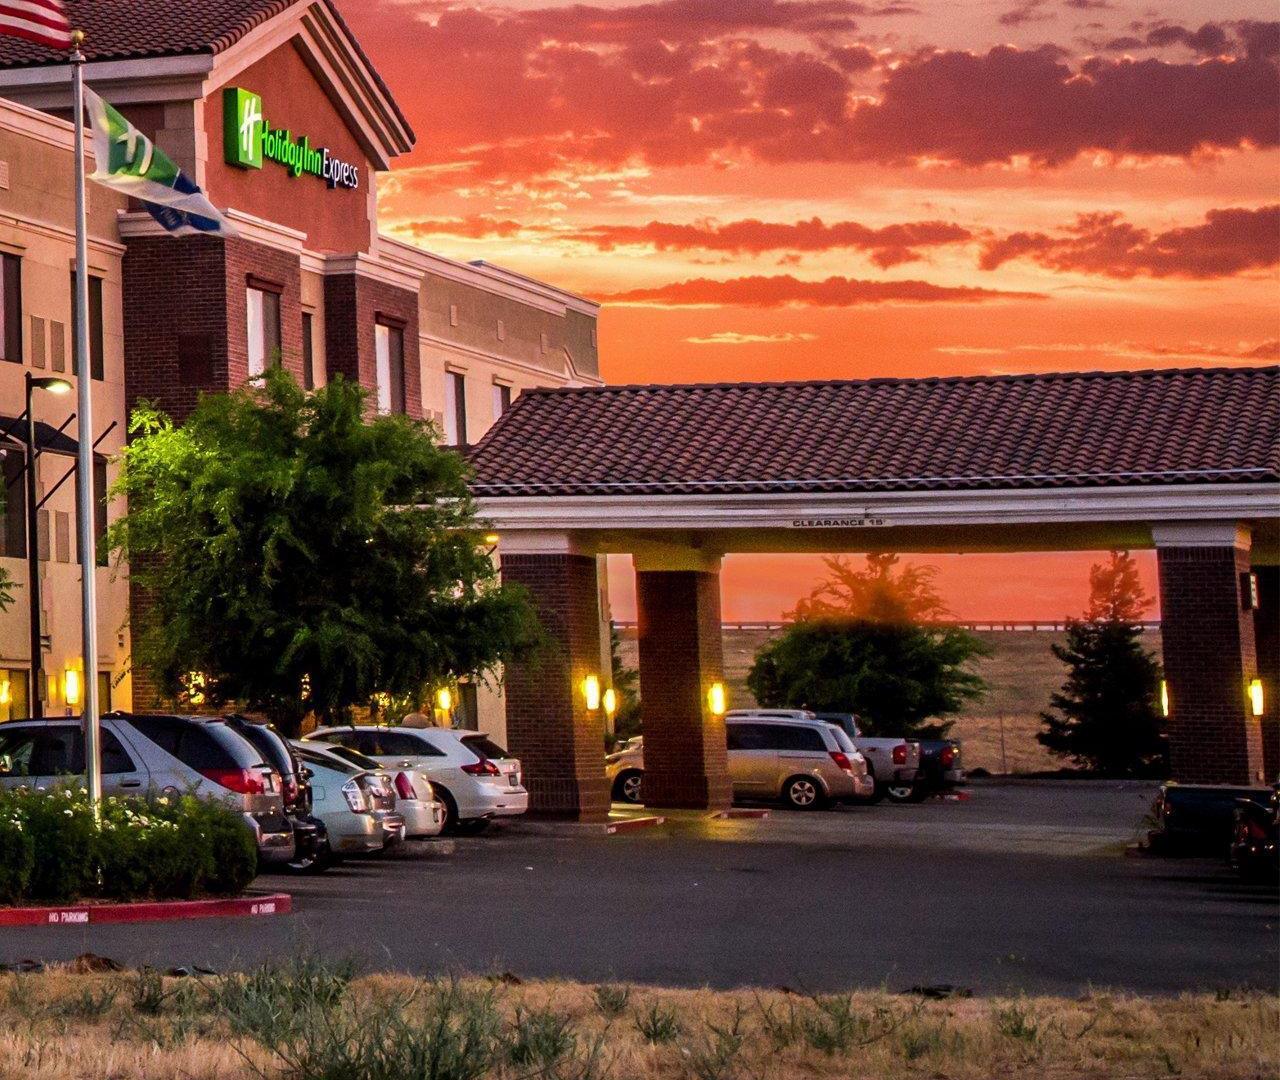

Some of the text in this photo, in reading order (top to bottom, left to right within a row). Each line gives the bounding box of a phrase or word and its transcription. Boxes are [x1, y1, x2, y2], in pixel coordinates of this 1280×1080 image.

[261, 120, 304, 178] Holiday
[304, 136, 321, 175] Inn
[322, 148, 359, 189] Express
[792, 519, 865, 527] CLEARANCE
[48, 911, 89, 923] NO PARKING
